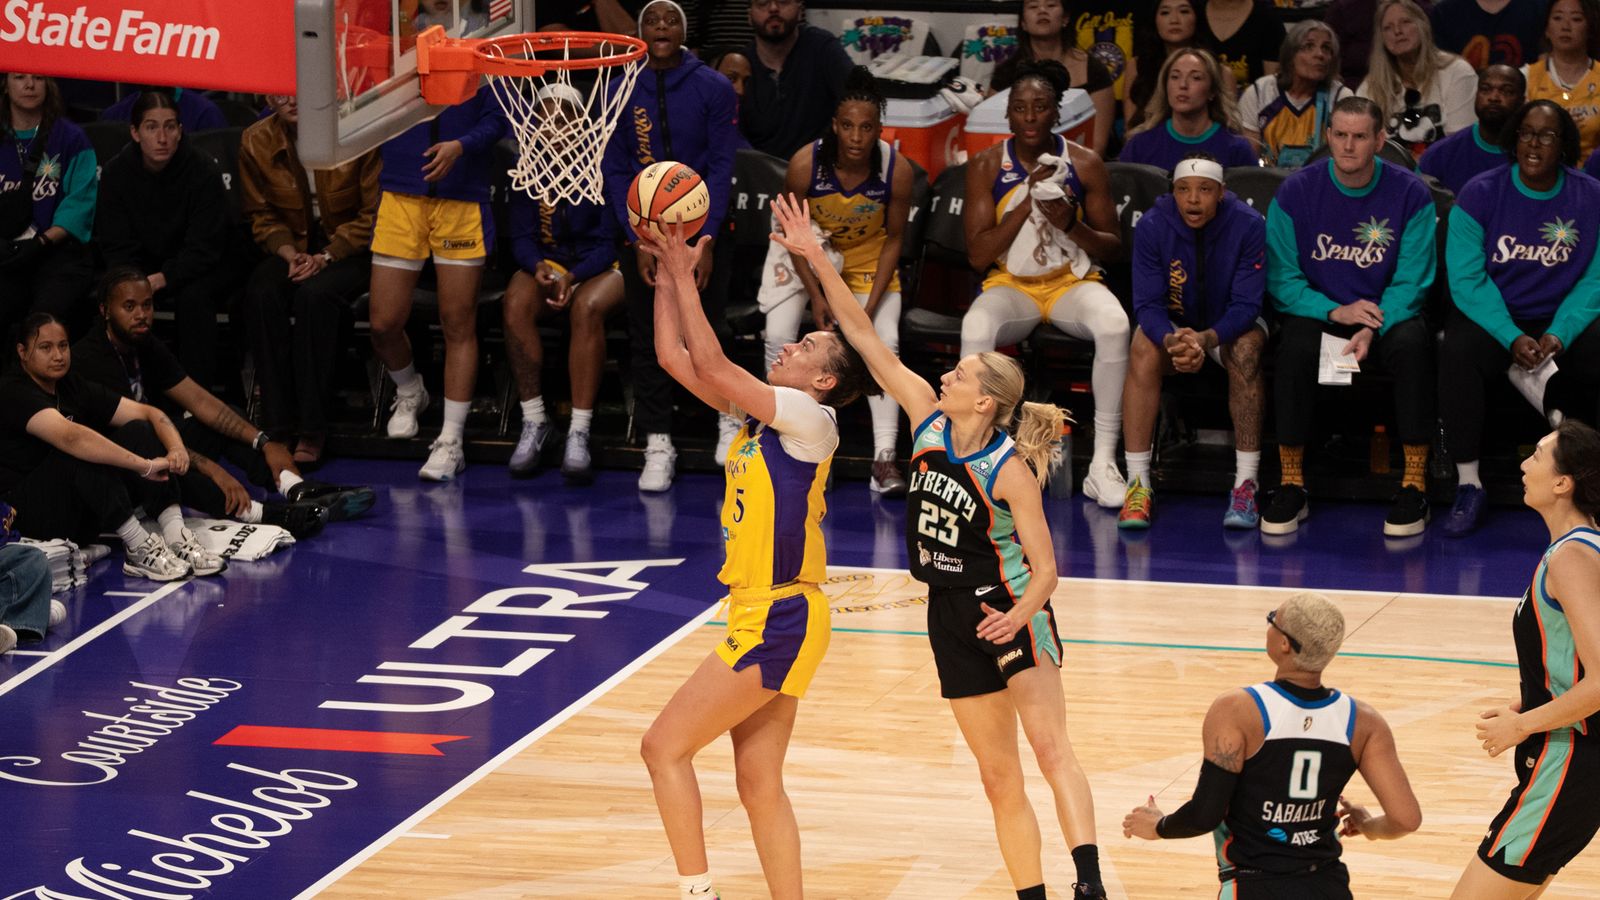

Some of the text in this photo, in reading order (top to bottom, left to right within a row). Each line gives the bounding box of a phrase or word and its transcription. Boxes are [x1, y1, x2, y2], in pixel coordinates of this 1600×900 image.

[0, 0, 220, 60] State Farm
[1311, 233, 1386, 268] SPARKS
[1491, 235, 1573, 267] SPARKS
[733, 488, 745, 523] 5
[908, 465, 978, 523] LIBERTY
[917, 499, 960, 548] 23
[932, 551, 963, 565] Liberty
[932, 560, 964, 573] Mutual
[318, 558, 685, 712] ULTRA
[0, 677, 242, 786] Courtside
[1289, 750, 1322, 799] 0
[1261, 800, 1327, 824] SABALLY
[1290, 829, 1321, 847] AT&T
